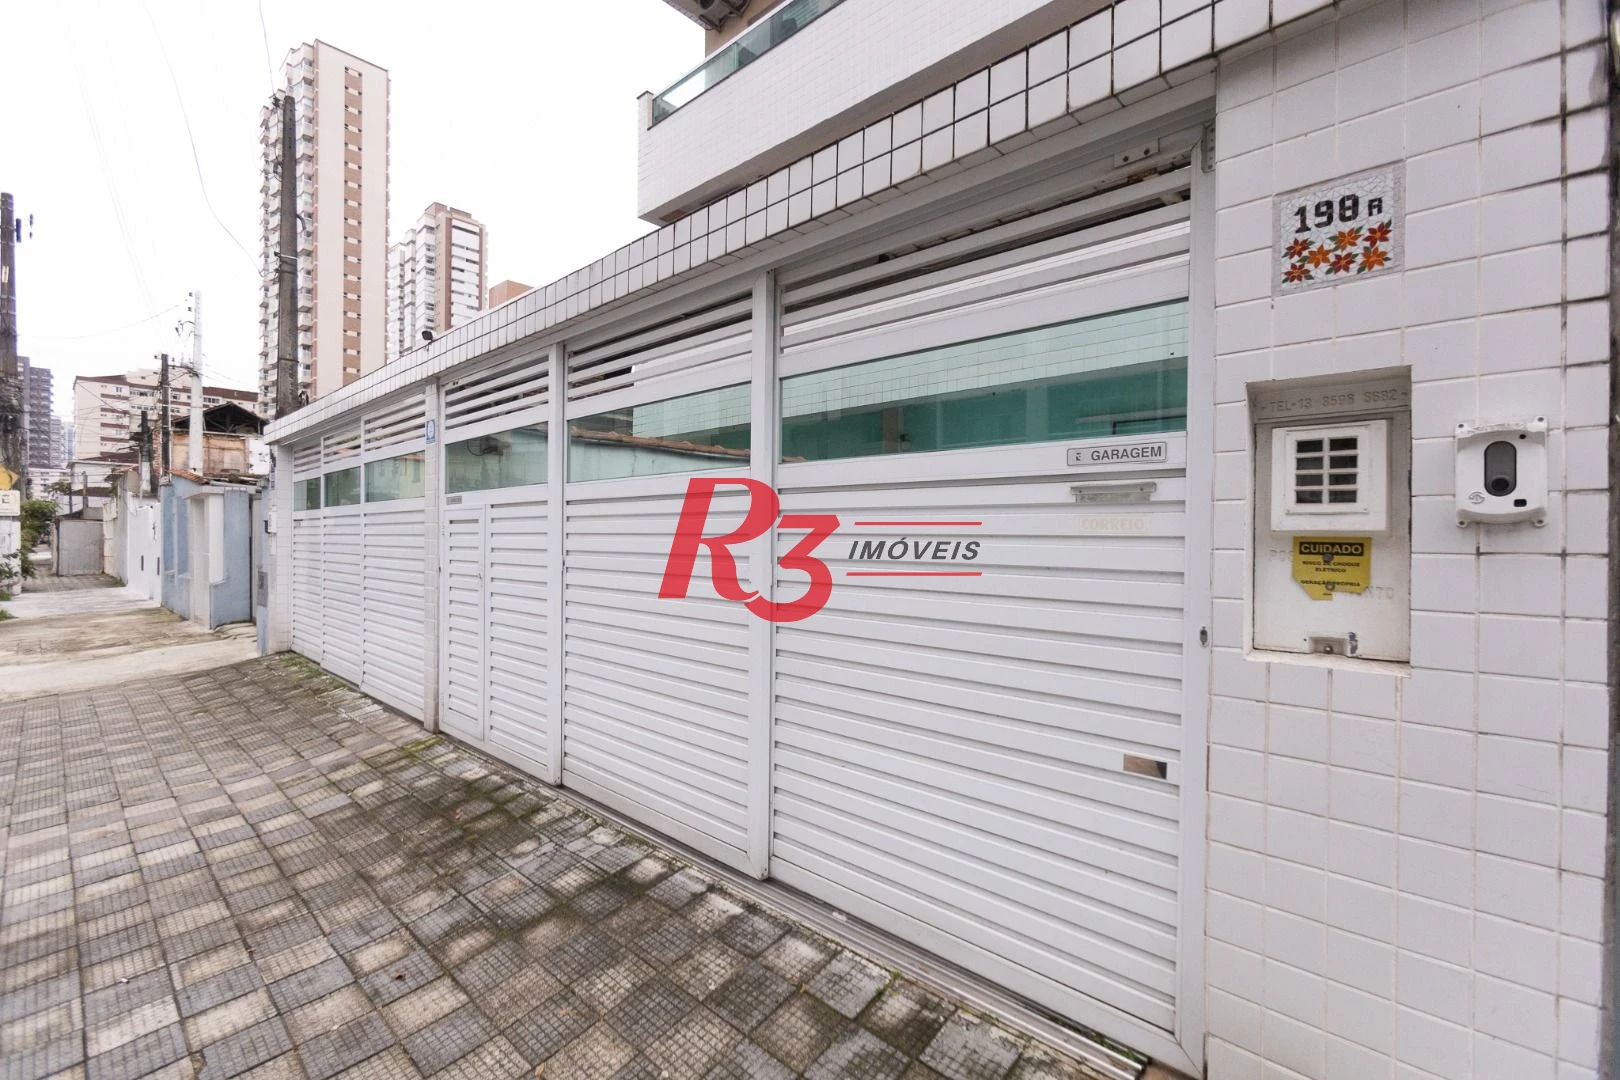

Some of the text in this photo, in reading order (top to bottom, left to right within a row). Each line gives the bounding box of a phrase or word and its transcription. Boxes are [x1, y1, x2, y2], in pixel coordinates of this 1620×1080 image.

[1294, 194, 1359, 233] 198
[1091, 446, 1162, 461] GARAGEM
[1082, 518, 1145, 530] CORREIO
[1301, 543, 1362, 554] CUIDADO
